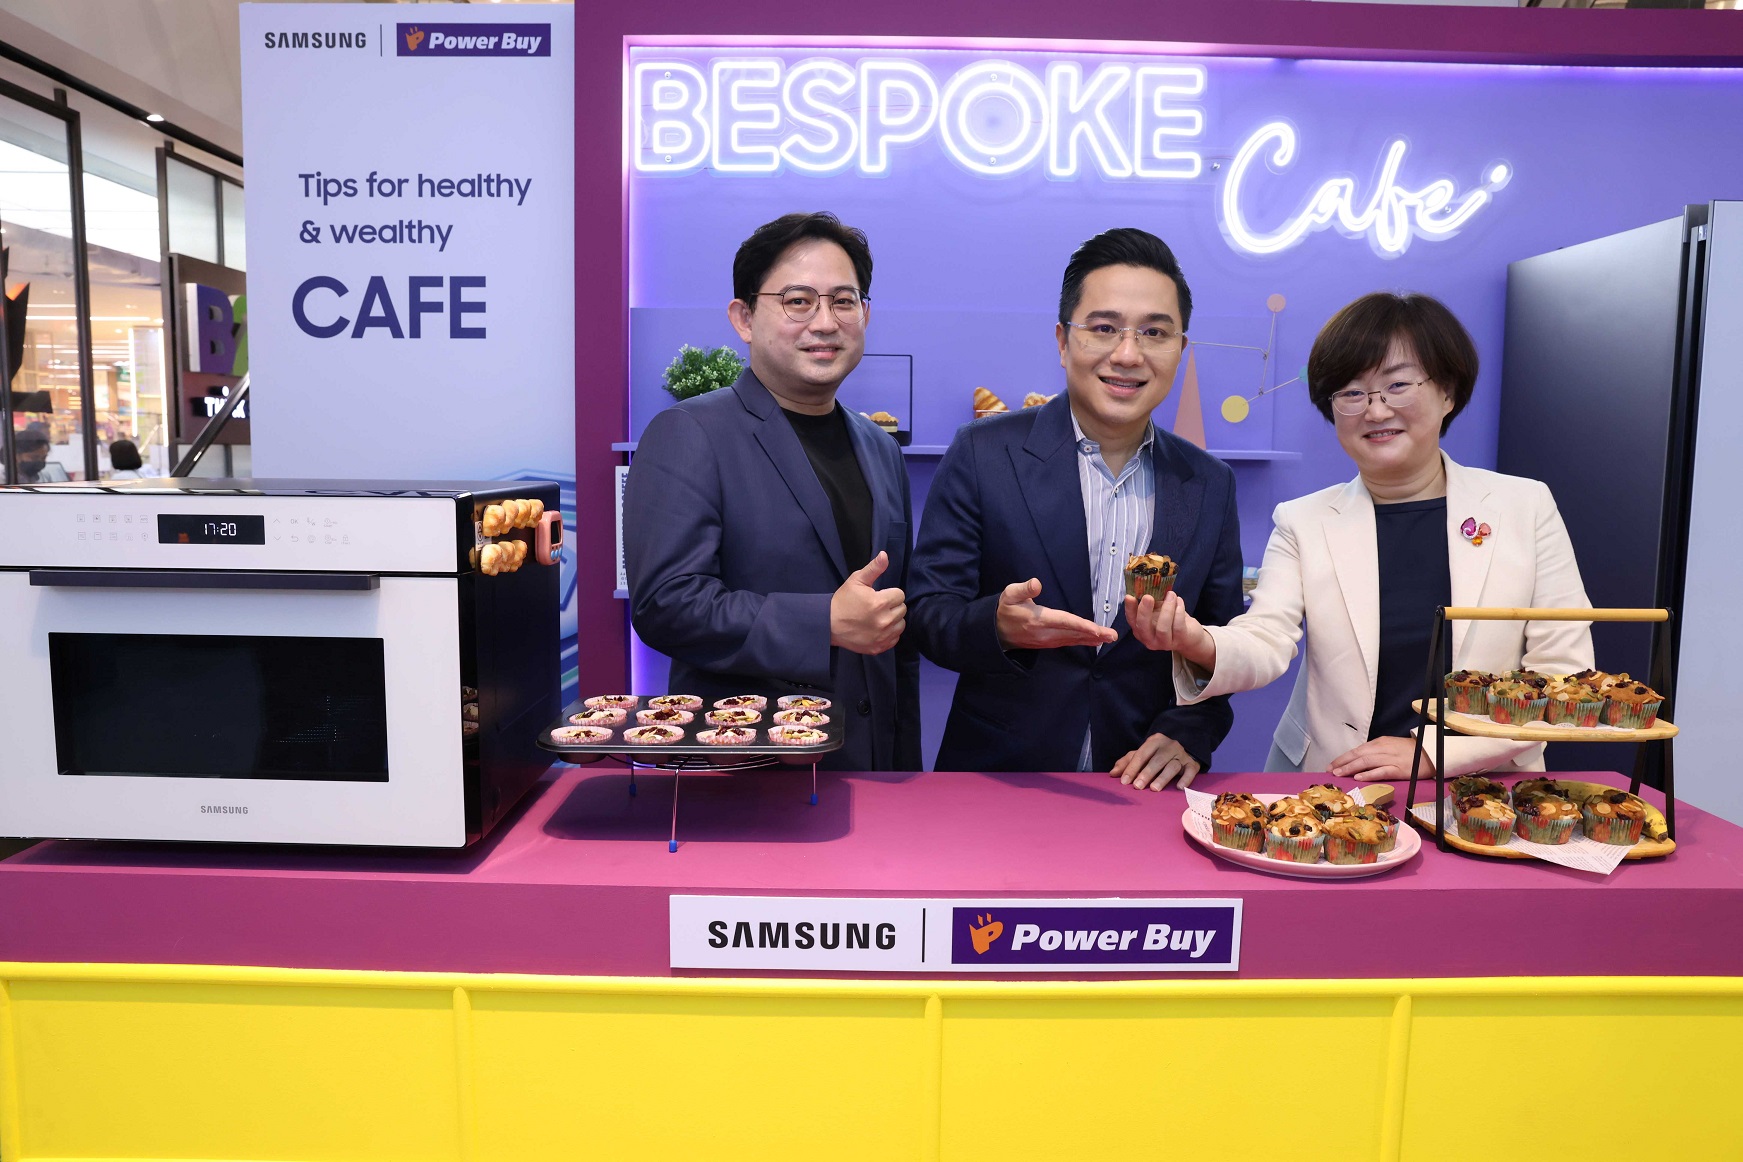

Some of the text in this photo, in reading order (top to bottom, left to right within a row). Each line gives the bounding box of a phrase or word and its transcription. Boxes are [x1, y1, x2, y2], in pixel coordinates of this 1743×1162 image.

[264, 32, 366, 49] SAMSUNG
[428, 32, 542, 53] Power Buy
[634, 60, 1205, 179] BESPOKE
[298, 171, 533, 206] Tips for healthy
[299, 219, 454, 252] & wealthy
[291, 275, 487, 339] CAFE
[204, 522, 237, 536] 17:20
[200, 805, 249, 815] SAMSUNG
[708, 920, 896, 950] SAMSUNG
[1011, 923, 1217, 958] Power Buy
